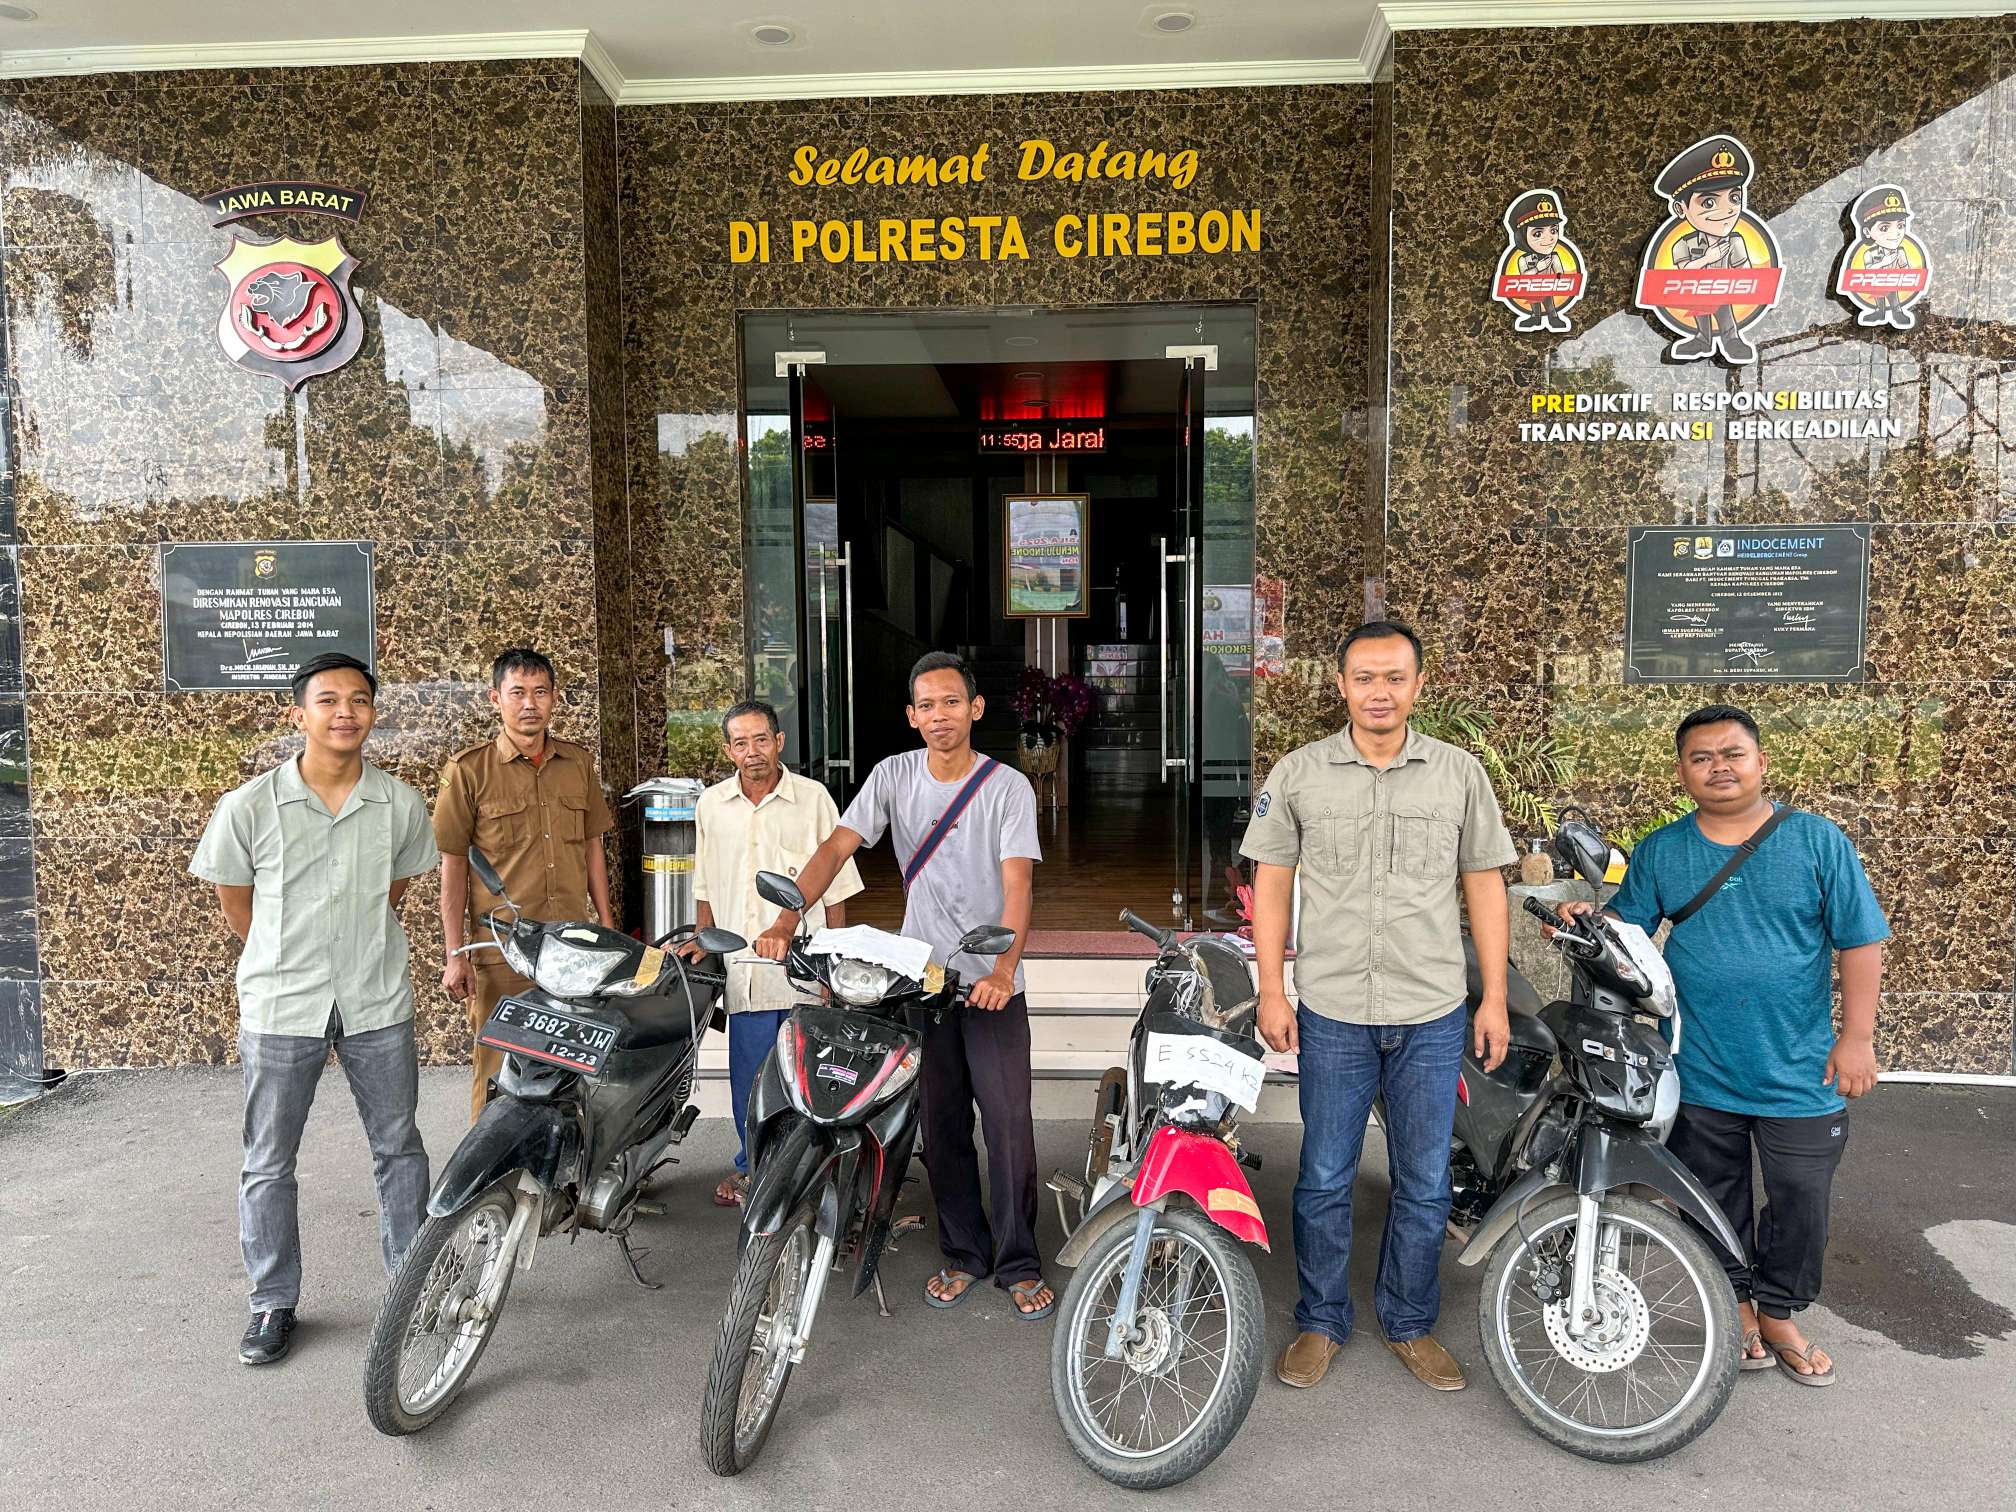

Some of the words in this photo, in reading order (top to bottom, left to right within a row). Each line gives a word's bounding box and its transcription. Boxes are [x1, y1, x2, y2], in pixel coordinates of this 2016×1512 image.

[788, 142, 990, 187] Selamat
[1018, 139, 1200, 190] Datang
[216, 191, 275, 215] JAWA
[280, 190, 353, 212] BARAT
[729, 221, 771, 263] DI
[793, 216, 1031, 262] POLRESTA
[1054, 209, 1261, 258] CIREBON
[1505, 277, 1575, 292] PRESISI
[1663, 278, 1759, 296] PRESISI
[1849, 273, 1921, 287] PRESISI
[1531, 392, 1653, 413] PREDIKTIF
[1672, 389, 1889, 412] RESPONSIBILITAS
[1518, 421, 1714, 443] TRANSPARANSI
[1728, 417, 1902, 441] BERKEADILAN
[1737, 537, 1824, 550] INDOCEMENT
[193, 597, 248, 609] DIRESMIKAN
[249, 597, 290, 608] RENOVASI
[293, 596, 341, 608] BANGUNAN
[219, 609, 272, 620] MAPOLRES
[275, 609, 315, 619] CIREBON
[499, 1004, 515, 1022] E
[523, 1012, 570, 1038] 3682
[583, 1029, 612, 1049] JW
[1159, 1044, 1172, 1062] E
